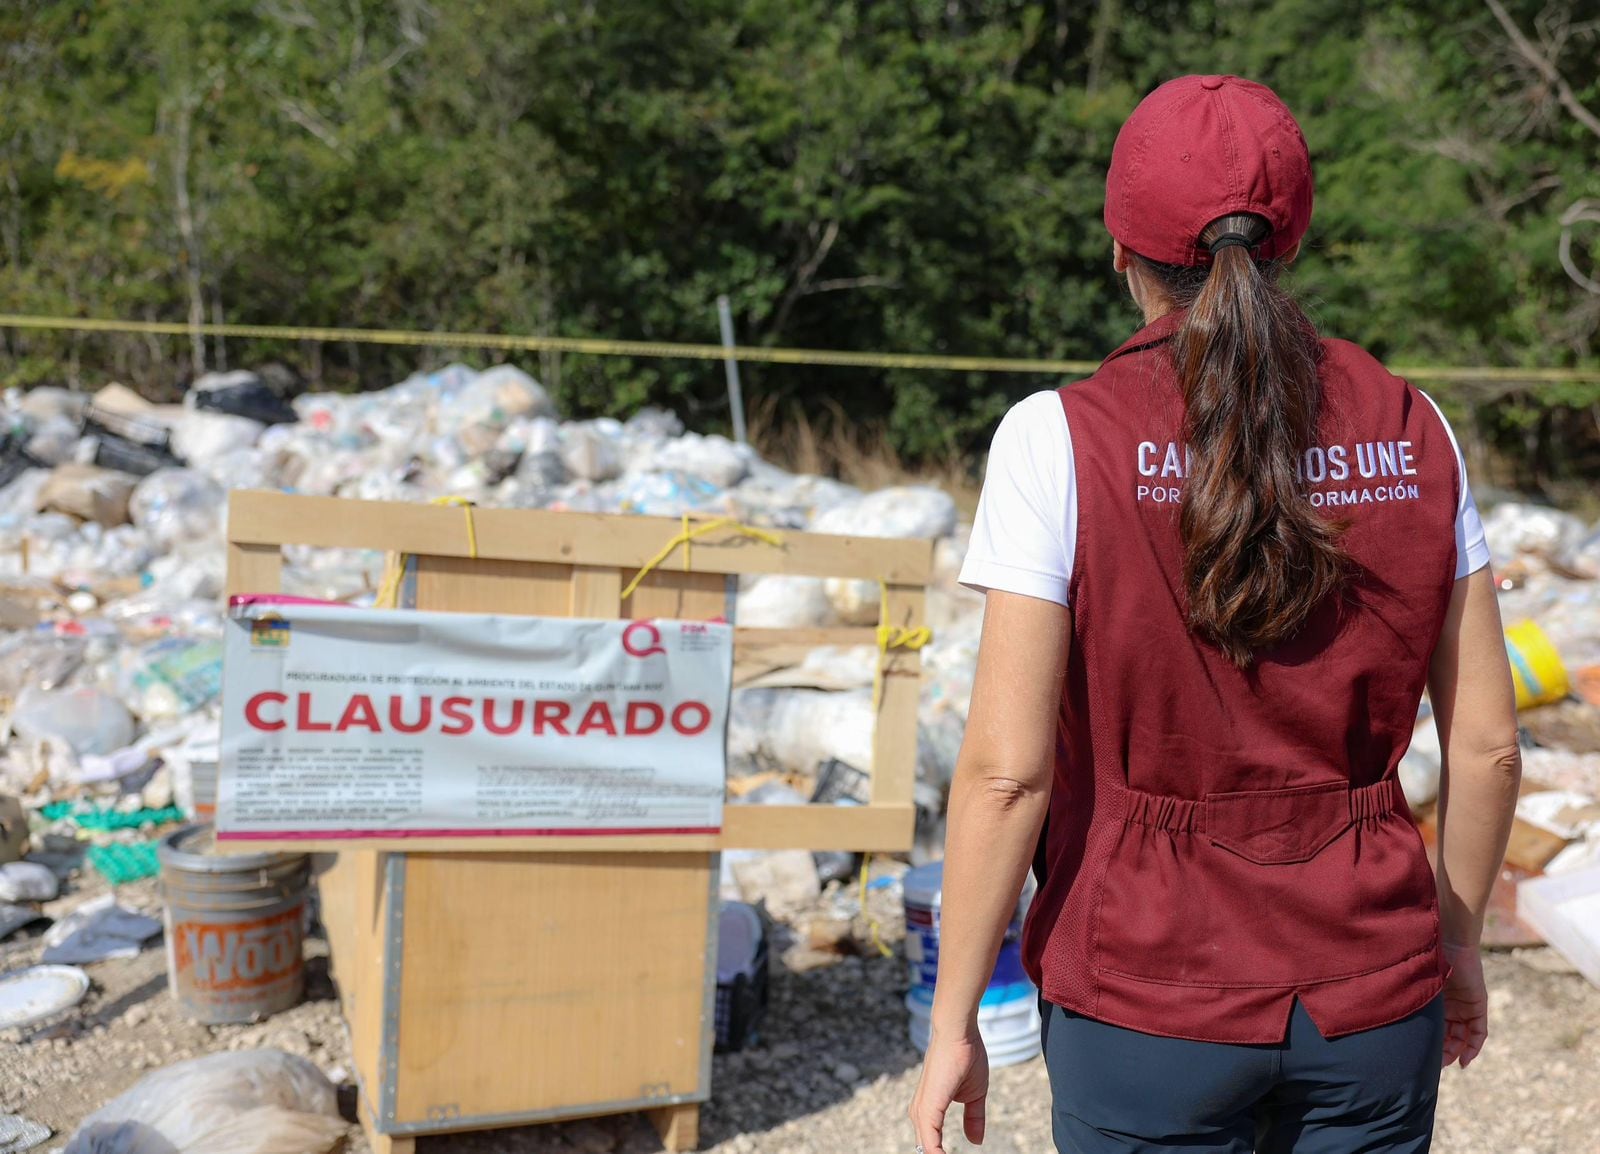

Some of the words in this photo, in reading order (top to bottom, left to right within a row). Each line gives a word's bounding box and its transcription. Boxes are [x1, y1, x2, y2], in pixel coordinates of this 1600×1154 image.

[1355, 441, 1417, 478] UNE
[1137, 485, 1181, 504] POR
[1301, 480, 1420, 507] ORMACIÓN
[244, 691, 711, 736] CLAUSURADO
